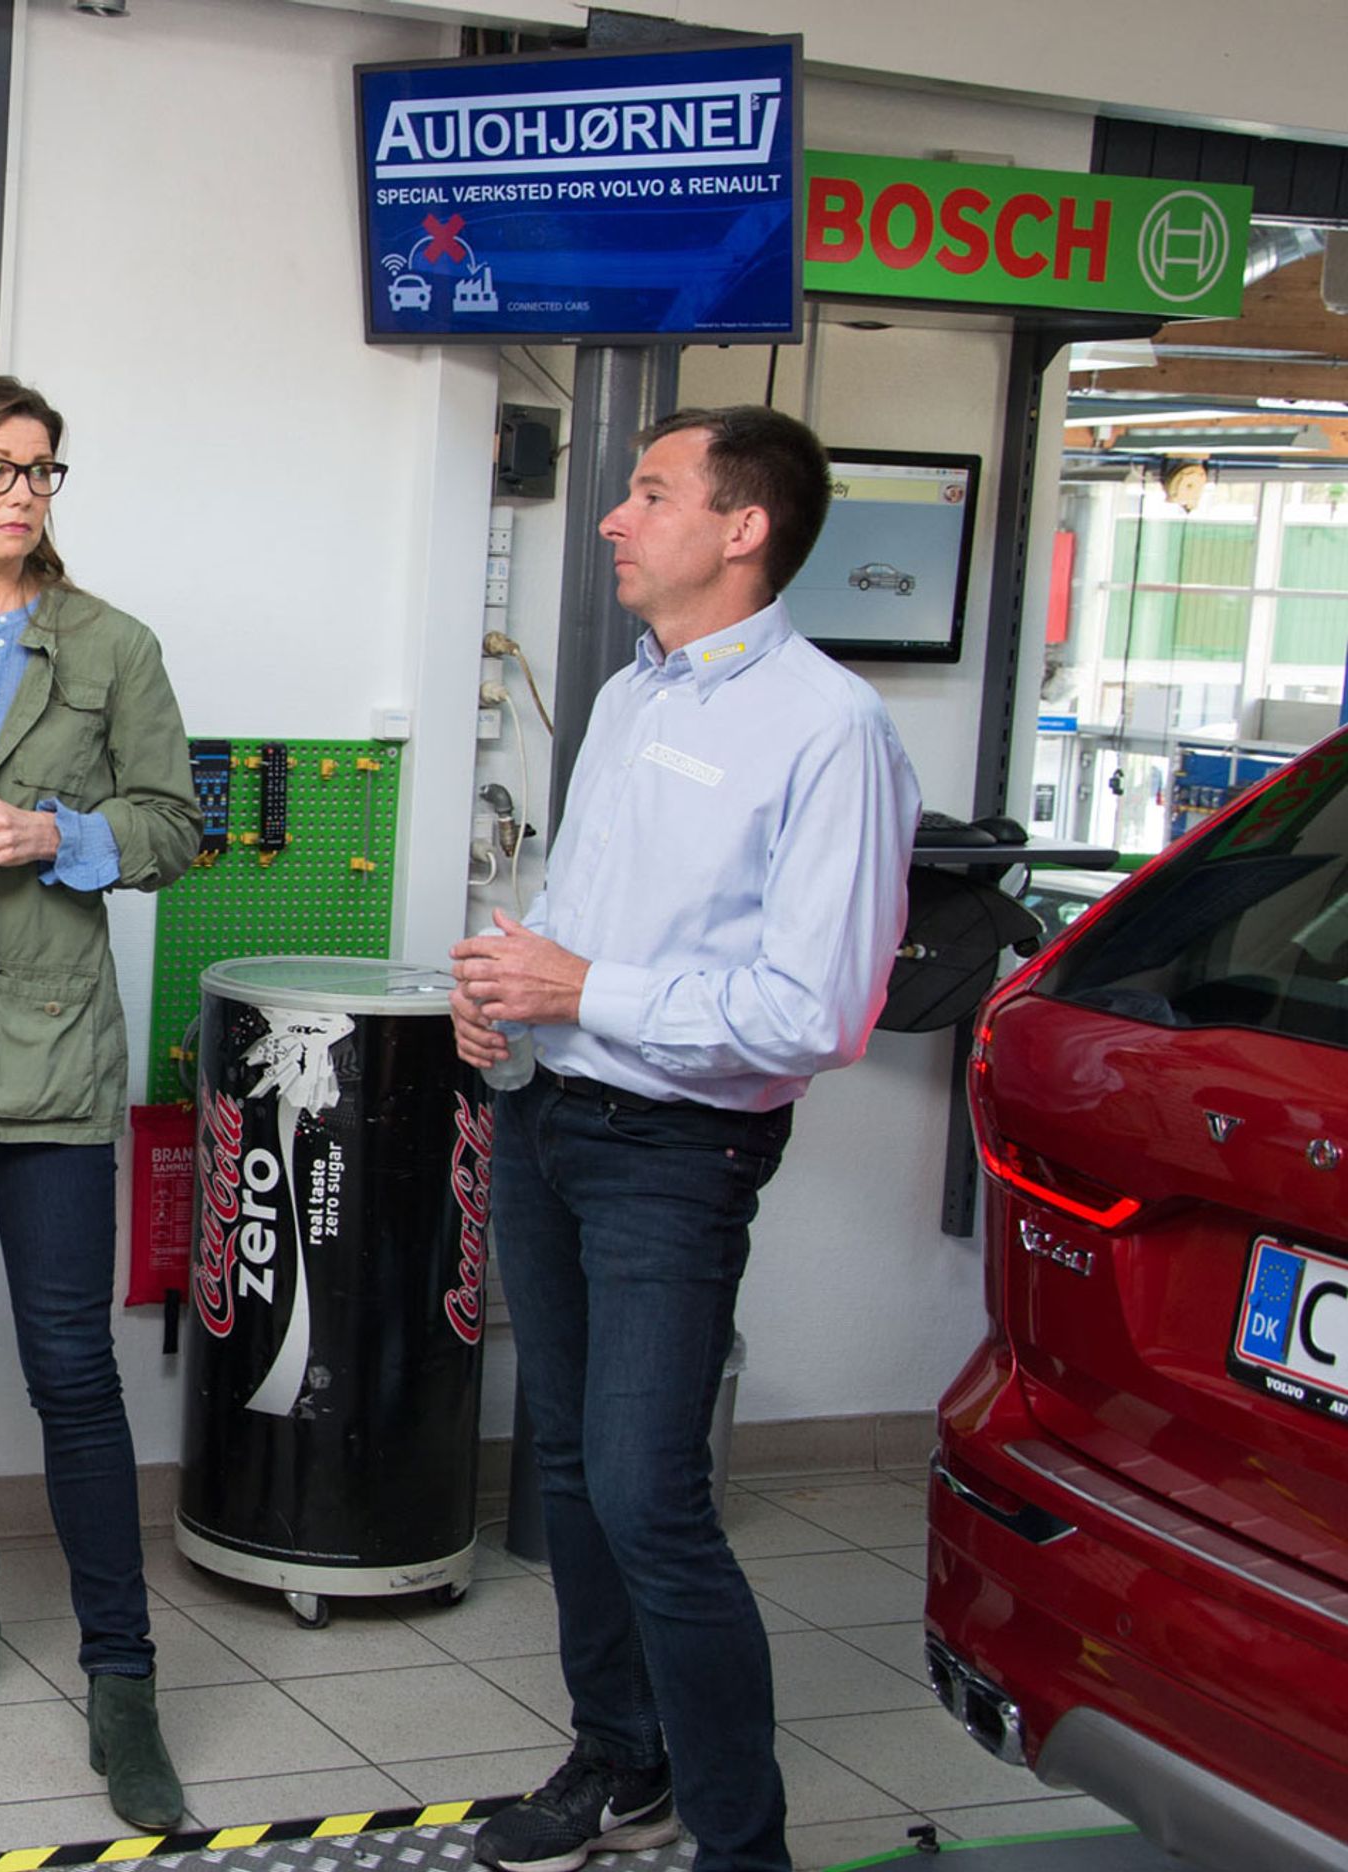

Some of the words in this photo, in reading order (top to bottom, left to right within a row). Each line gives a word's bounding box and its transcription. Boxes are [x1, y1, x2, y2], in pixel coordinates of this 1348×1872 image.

[375, 80, 762, 165] AUTOHJØRNET
[376, 187, 449, 205] SPECIAL
[452, 183, 553, 203] VÆRKSTED
[557, 181, 596, 199] FOR
[600, 178, 665, 197] VOLVO
[669, 177, 684, 195] &
[688, 174, 782, 195] RENAULT
[803, 176, 1113, 283] BOSCH
[506, 301, 563, 312] CONNECTED
[565, 301, 591, 312] CARS
[308, 1158, 327, 1204] taste
[327, 1140, 346, 1194] sugar
[238, 1148, 281, 1305] zero
[307, 1208, 324, 1245] real
[325, 1197, 340, 1236] zero
[1251, 1312, 1280, 1343] DK
[1299, 1280, 1348, 1366] C
[1265, 1376, 1305, 1400] VOLVO
